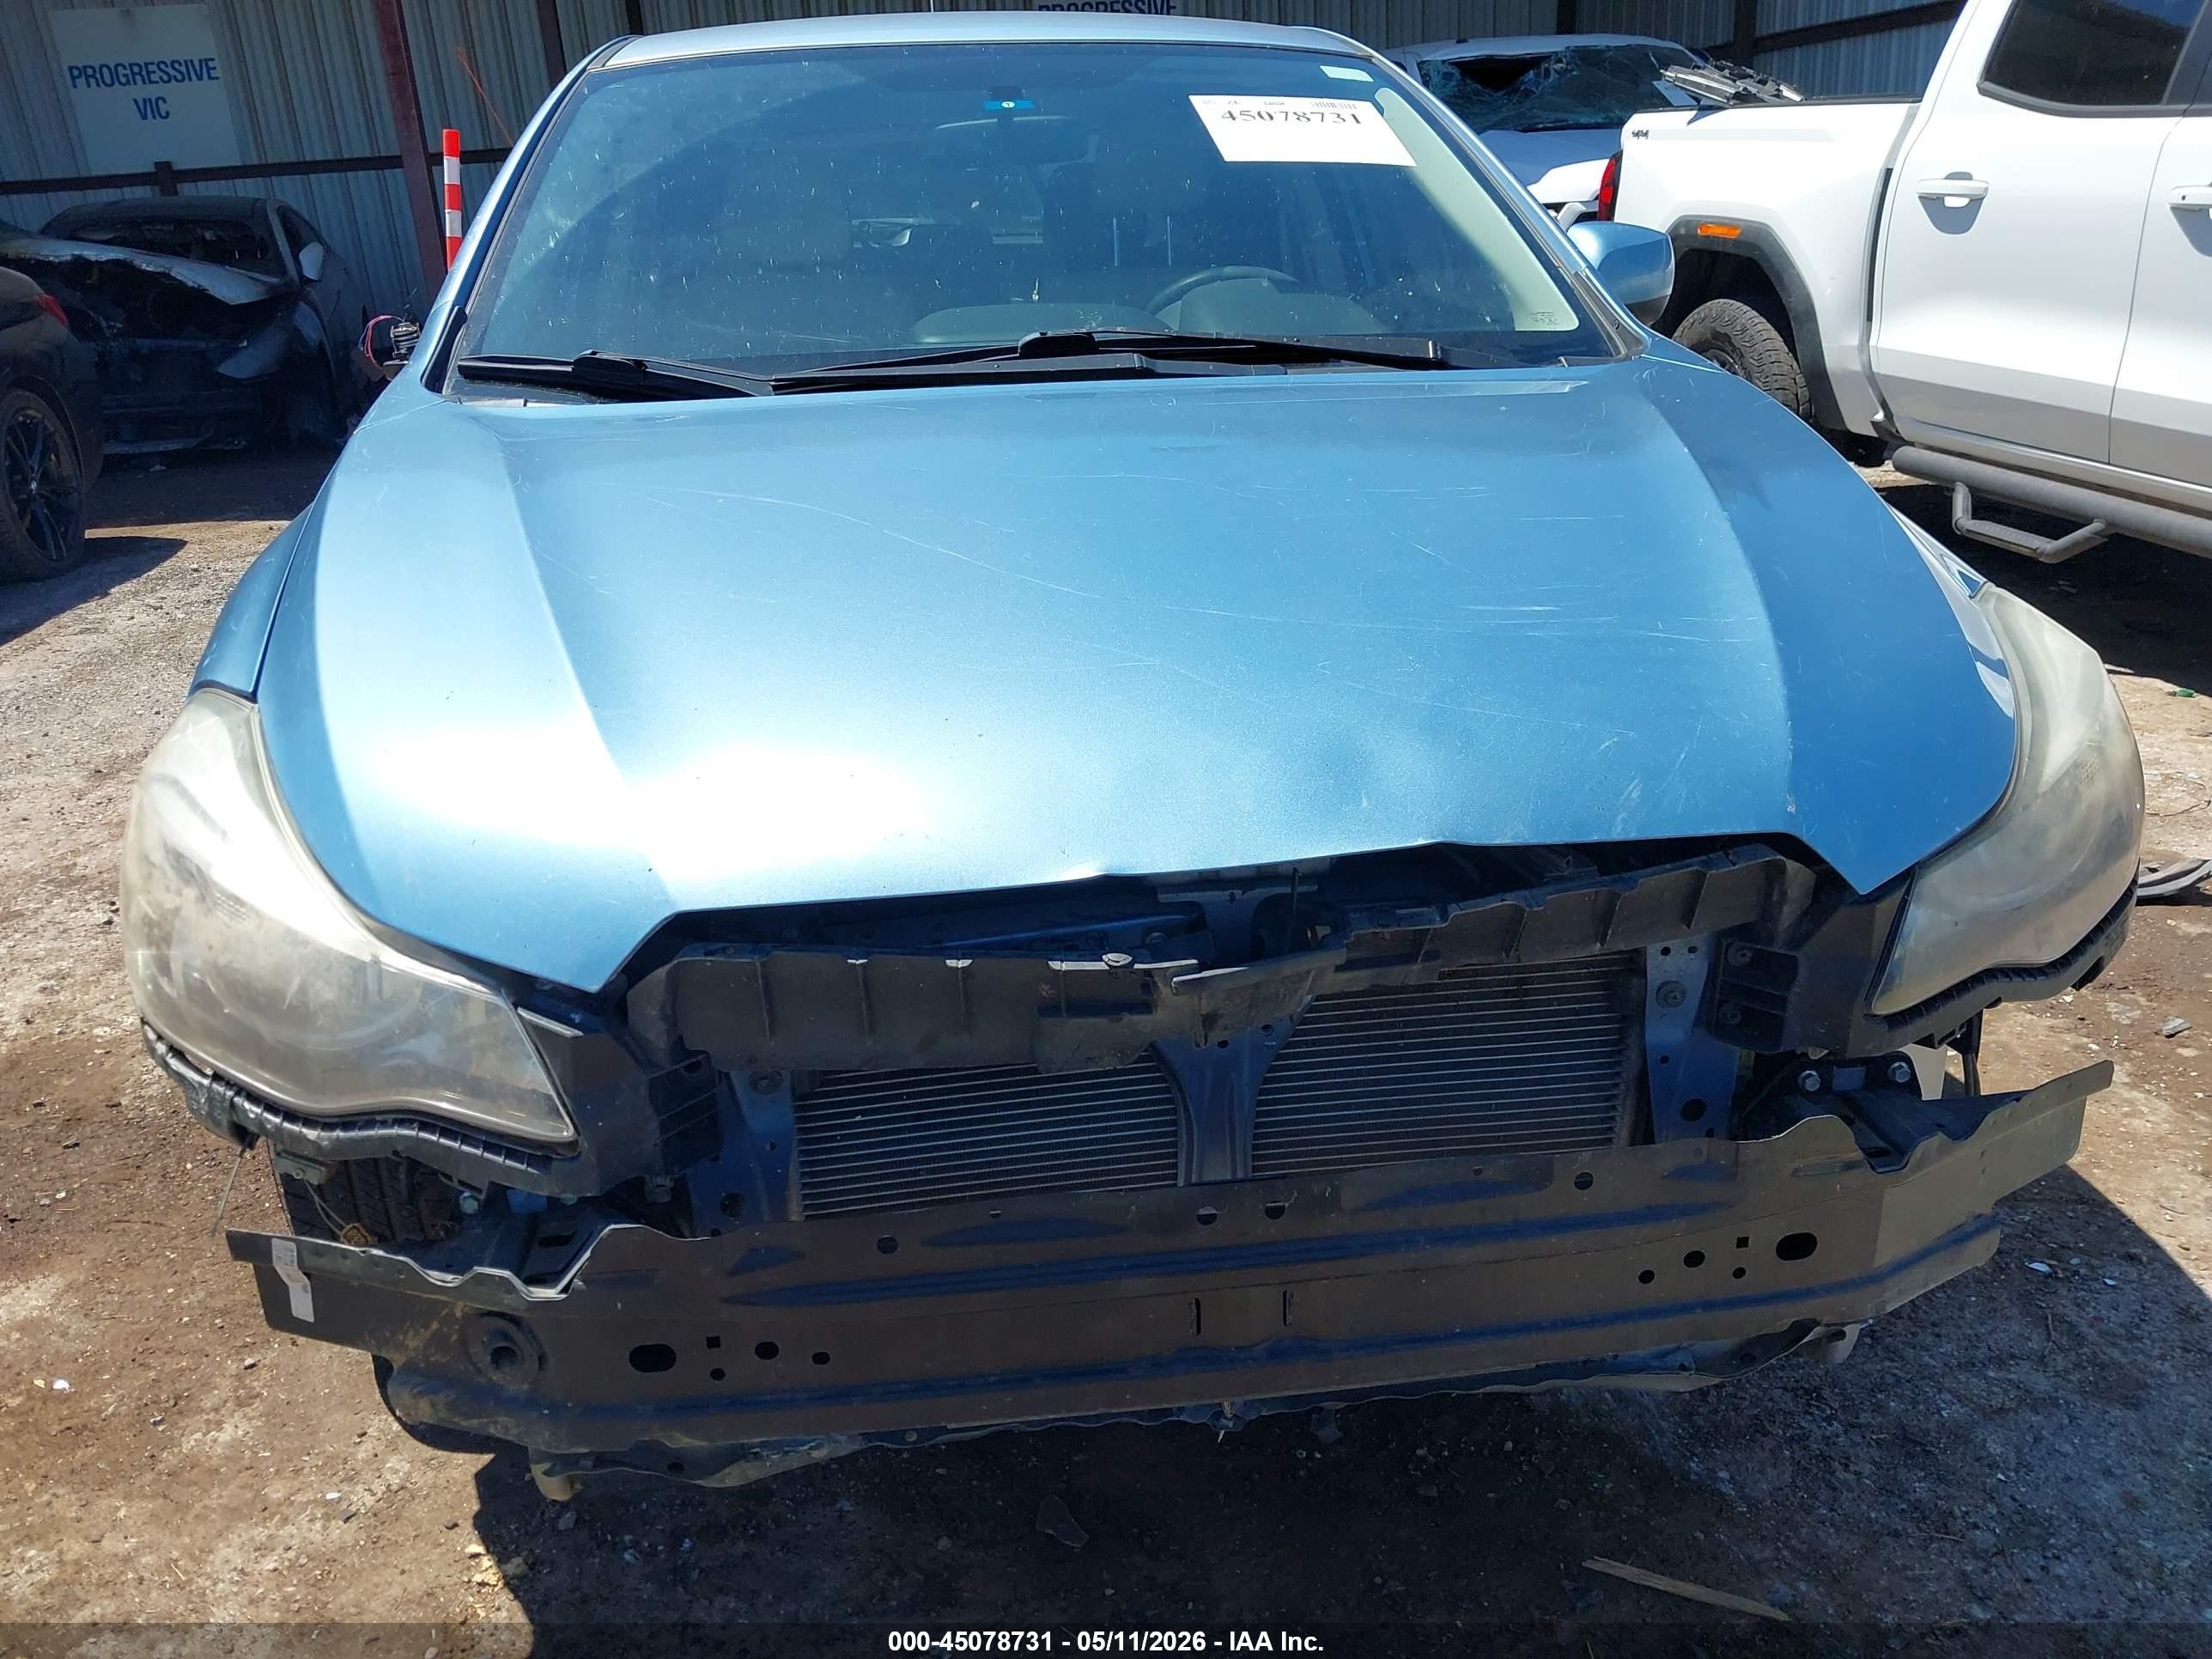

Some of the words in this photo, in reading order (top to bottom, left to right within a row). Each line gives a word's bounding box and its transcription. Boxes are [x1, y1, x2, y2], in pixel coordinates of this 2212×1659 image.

[67, 58, 220, 88] PROGRESSIVE
[133, 96, 170, 120] VIC
[1220, 109, 1363, 125] 45078731
